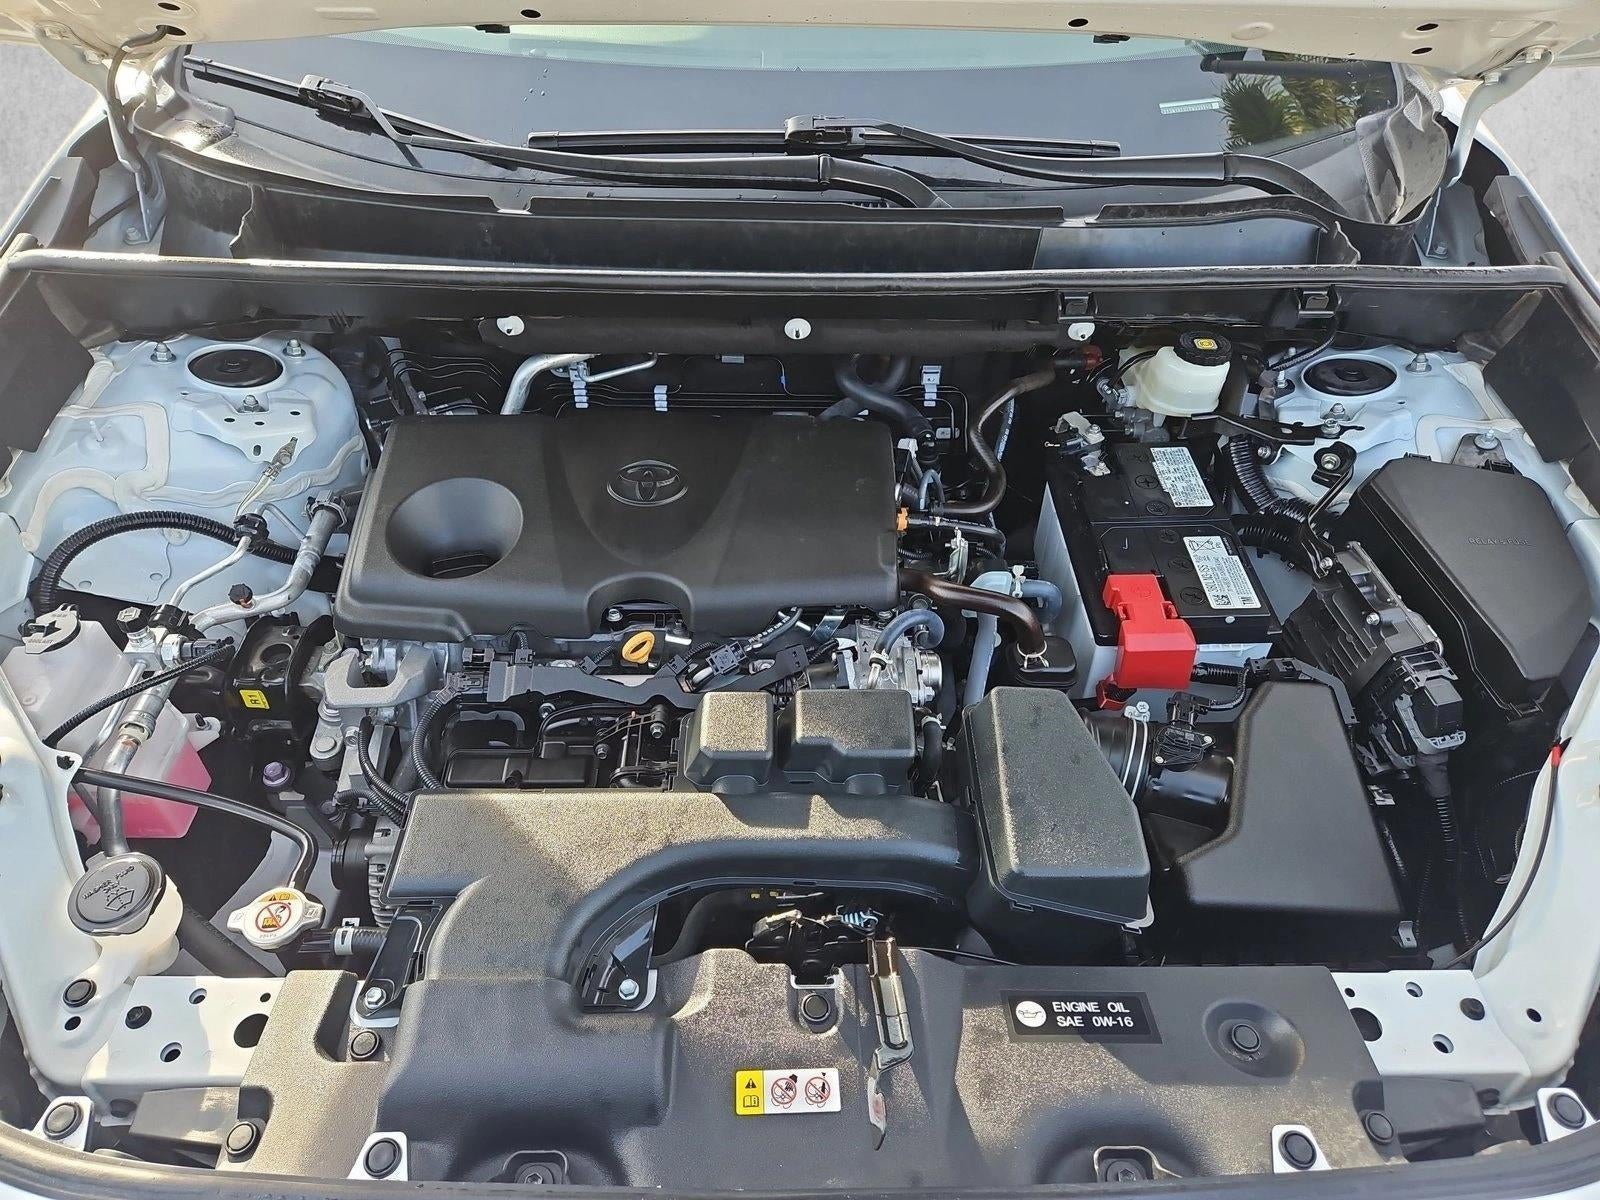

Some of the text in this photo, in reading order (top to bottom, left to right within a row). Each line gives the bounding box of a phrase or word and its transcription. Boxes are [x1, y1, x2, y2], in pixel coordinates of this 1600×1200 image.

[1052, 1001, 1130, 1013] ENGINE OIL
[1056, 1016, 1134, 1028] SAE 0W-16
